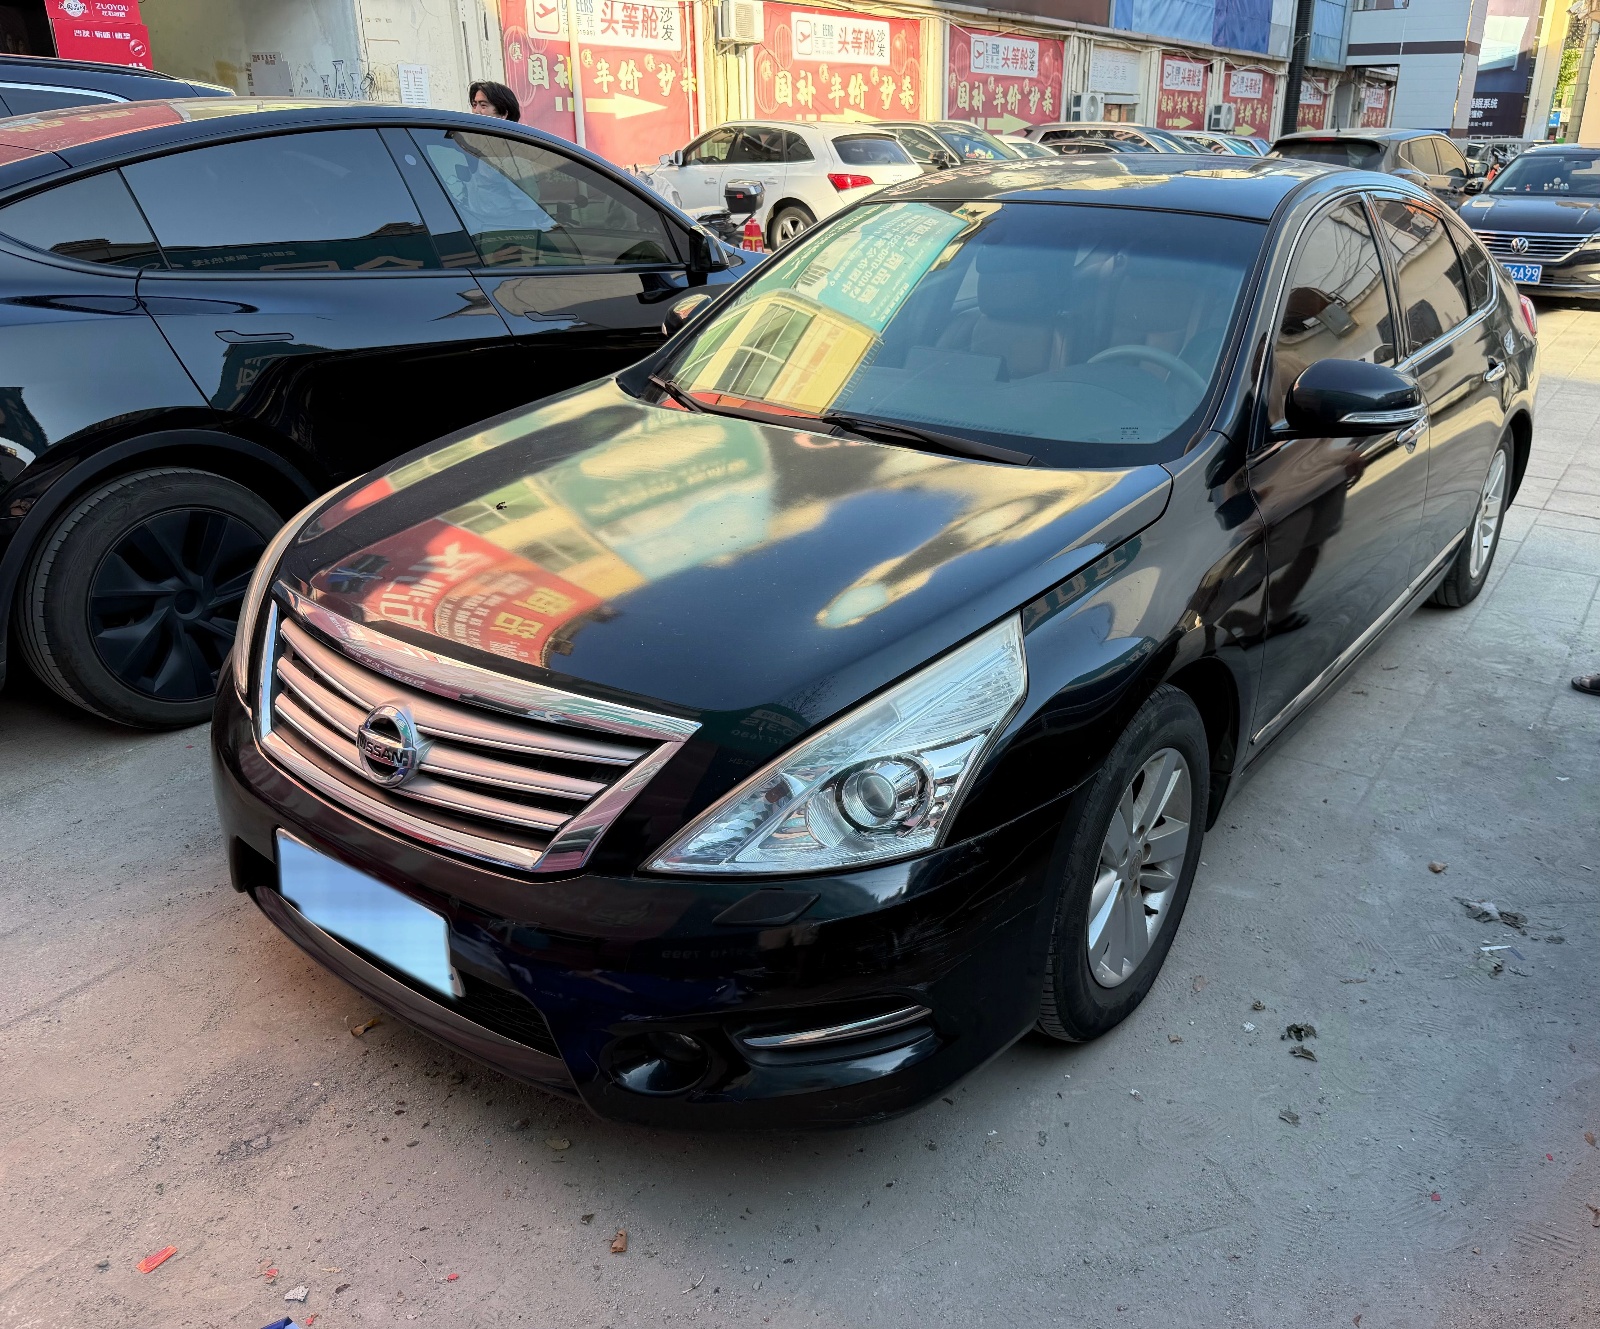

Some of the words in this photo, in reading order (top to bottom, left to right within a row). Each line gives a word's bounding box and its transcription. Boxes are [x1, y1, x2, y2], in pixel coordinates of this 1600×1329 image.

[95, 2, 129, 12] ZUOYOU
[600, 1, 659, 39] 头等舱
[660, 7, 674, 42] 沙发
[838, 26, 876, 56] 头等舱
[1001, 46, 1029, 70] 头等舱
[358, 733, 404, 764] NISSAN
